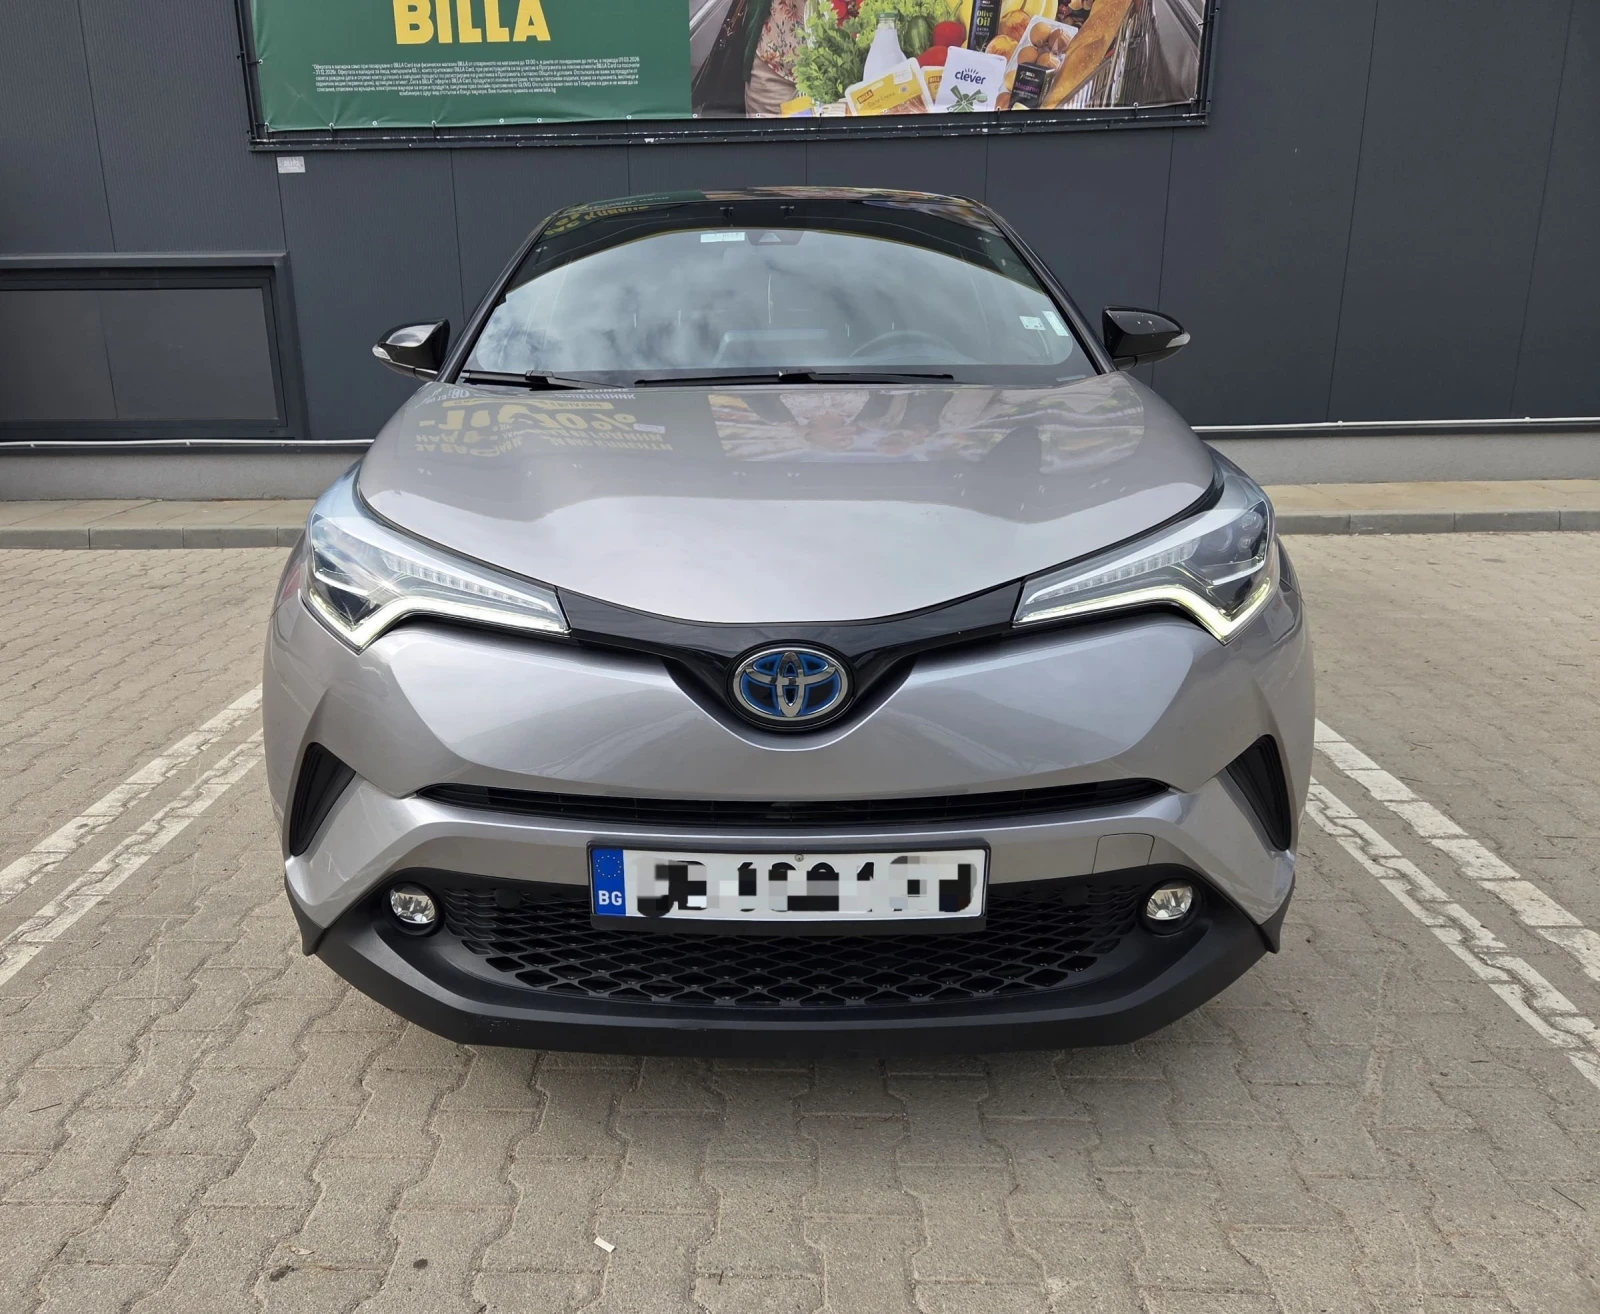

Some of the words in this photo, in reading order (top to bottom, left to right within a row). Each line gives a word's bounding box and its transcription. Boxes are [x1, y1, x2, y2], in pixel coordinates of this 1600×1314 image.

[393, 0, 552, 44] BILLA
[976, 17, 990, 26] Oil
[955, 71, 986, 85] clever
[598, 890, 623, 906] BG
